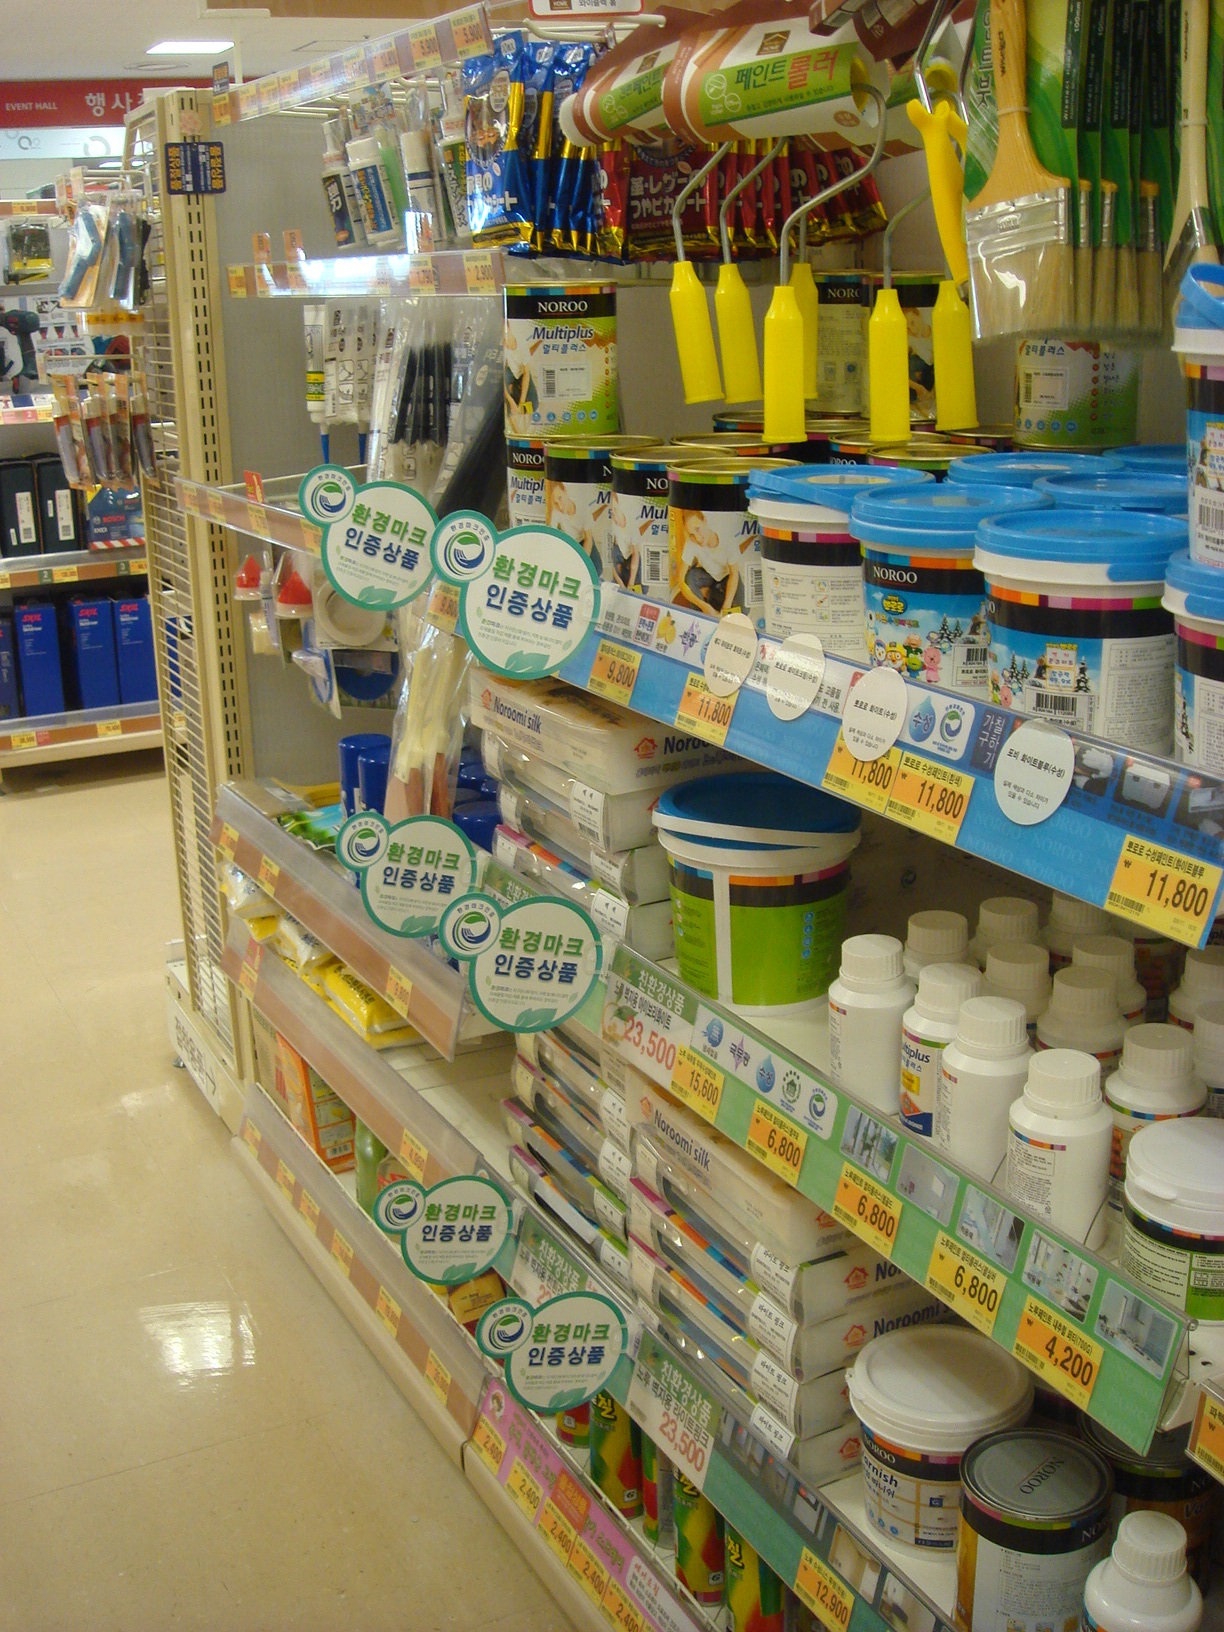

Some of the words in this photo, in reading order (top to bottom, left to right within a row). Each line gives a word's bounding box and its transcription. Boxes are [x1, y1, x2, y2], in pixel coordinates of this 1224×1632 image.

[6, 102, 32, 111] EVENT
[35, 102, 57, 110] HALL
[85, 92, 144, 117] 행사
[538, 300, 588, 313] NOROO
[532, 326, 593, 343] Multiplus
[543, 343, 586, 355] 멀티플러스
[103, 515, 126, 523] BOSCH
[350, 503, 428, 547] 환경마크
[345, 527, 421, 571] 인증상품
[492, 553, 582, 600] 환경마크
[873, 566, 918, 584] NOROO
[22, 613, 42, 624] SKIL
[79, 607, 98, 618] SKIL
[119, 603, 139, 613] SKIL
[486, 584, 574, 630] 인증상품
[606, 660, 635, 688] 9,800
[493, 696, 528, 728] Noroomi
[528, 713, 543, 734] silk
[697, 696, 732, 726] 11,800
[853, 699, 868, 712] 뽀로로
[868, 704, 898, 721] 화이트(수성)
[912, 712, 932, 732] 수성
[851, 758, 893, 790] 11,800
[903, 756, 921, 771] 뽀로로
[921, 762, 963, 787] 수성페인트(흰색)
[1020, 754, 1066, 779] 화이트블루(수성)
[917, 780, 964, 819] 11,800
[387, 842, 461, 871] 환경마크
[1126, 841, 1144, 857] 뽀로로
[1144, 846, 1205, 880] 수성페인트(화이트블루
[383, 866, 455, 894] 인증상품
[1146, 869, 1209, 917] 11,800
[499, 927, 584, 957] 환경마크
[494, 953, 579, 983] 인증상품
[638, 969, 684, 1016] 친환경상품
[623, 1015, 677, 1071] 23,500
[689, 1069, 719, 1106] 15,600
[758, 1067, 774, 1085] 수성
[654, 1107, 694, 1155] Noroomi
[693, 1146, 711, 1171] silk
[767, 1128, 802, 1167] 6,800
[424, 1203, 496, 1222] 환경마크
[857, 1194, 896, 1238] 6,800
[422, 1224, 493, 1242] 인증상품
[940, 1236, 961, 1257] 노루페인트
[953, 1264, 998, 1313] 6,800
[531, 1323, 610, 1343] 환경마크
[1027, 1300, 1052, 1327] 노루페인트
[1066, 1329, 1093, 1354] 퍼티(700G)
[528, 1345, 605, 1367] 인증상품
[1045, 1334, 1093, 1386] 4,200
[661, 1359, 712, 1425] 친환경상품
[659, 1411, 706, 1470] 23,500
[671, 1402, 709, 1449] 라이트핑크
[482, 1435, 504, 1461] 2,400
[863, 1455, 899, 1489] arnish
[1019, 1456, 1064, 1494] NOROO
[519, 1478, 540, 1510] 2,400
[550, 1520, 572, 1555] 2,400
[582, 1562, 605, 1596] 2,400
[614, 1603, 639, 1632] 2,400
[814, 1579, 849, 1625] 12,900
